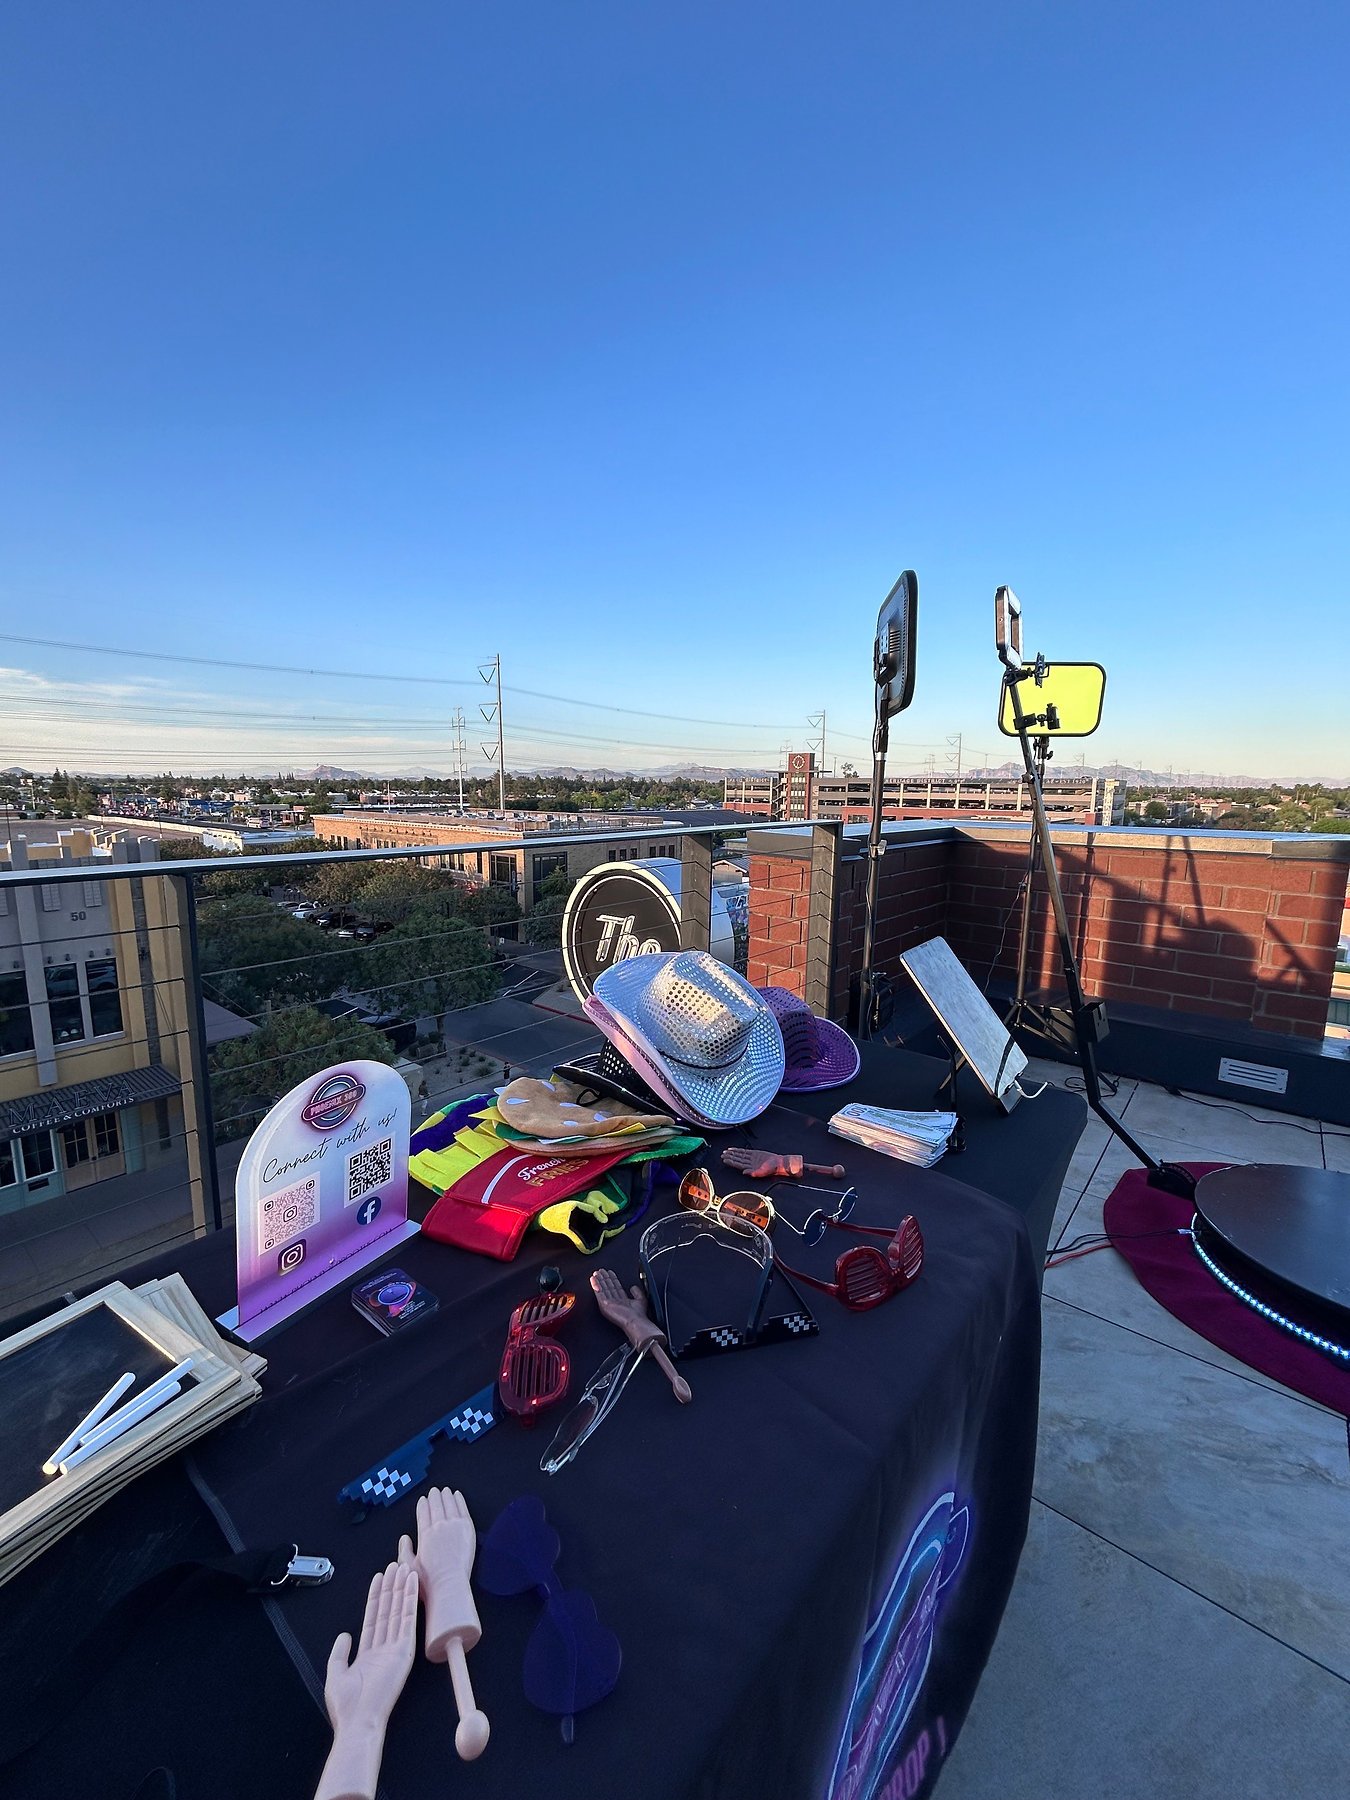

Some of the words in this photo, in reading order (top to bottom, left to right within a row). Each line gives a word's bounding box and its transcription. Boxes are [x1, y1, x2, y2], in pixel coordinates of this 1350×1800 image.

[70, 911, 87, 922] 50
[8, 1079, 137, 1128] MAEVA
[12, 1117, 61, 1134] COFFEE
[63, 1113, 72, 1121] &
[74, 1097, 135, 1117] COMFORTS
[310, 1096, 342, 1116] PHOENIX
[263, 1138, 332, 1183] Connect
[337, 1117, 370, 1148] with
[378, 1108, 398, 1128] us!
[517, 1158, 566, 1181] French
[525, 1159, 590, 1187] FRIES
